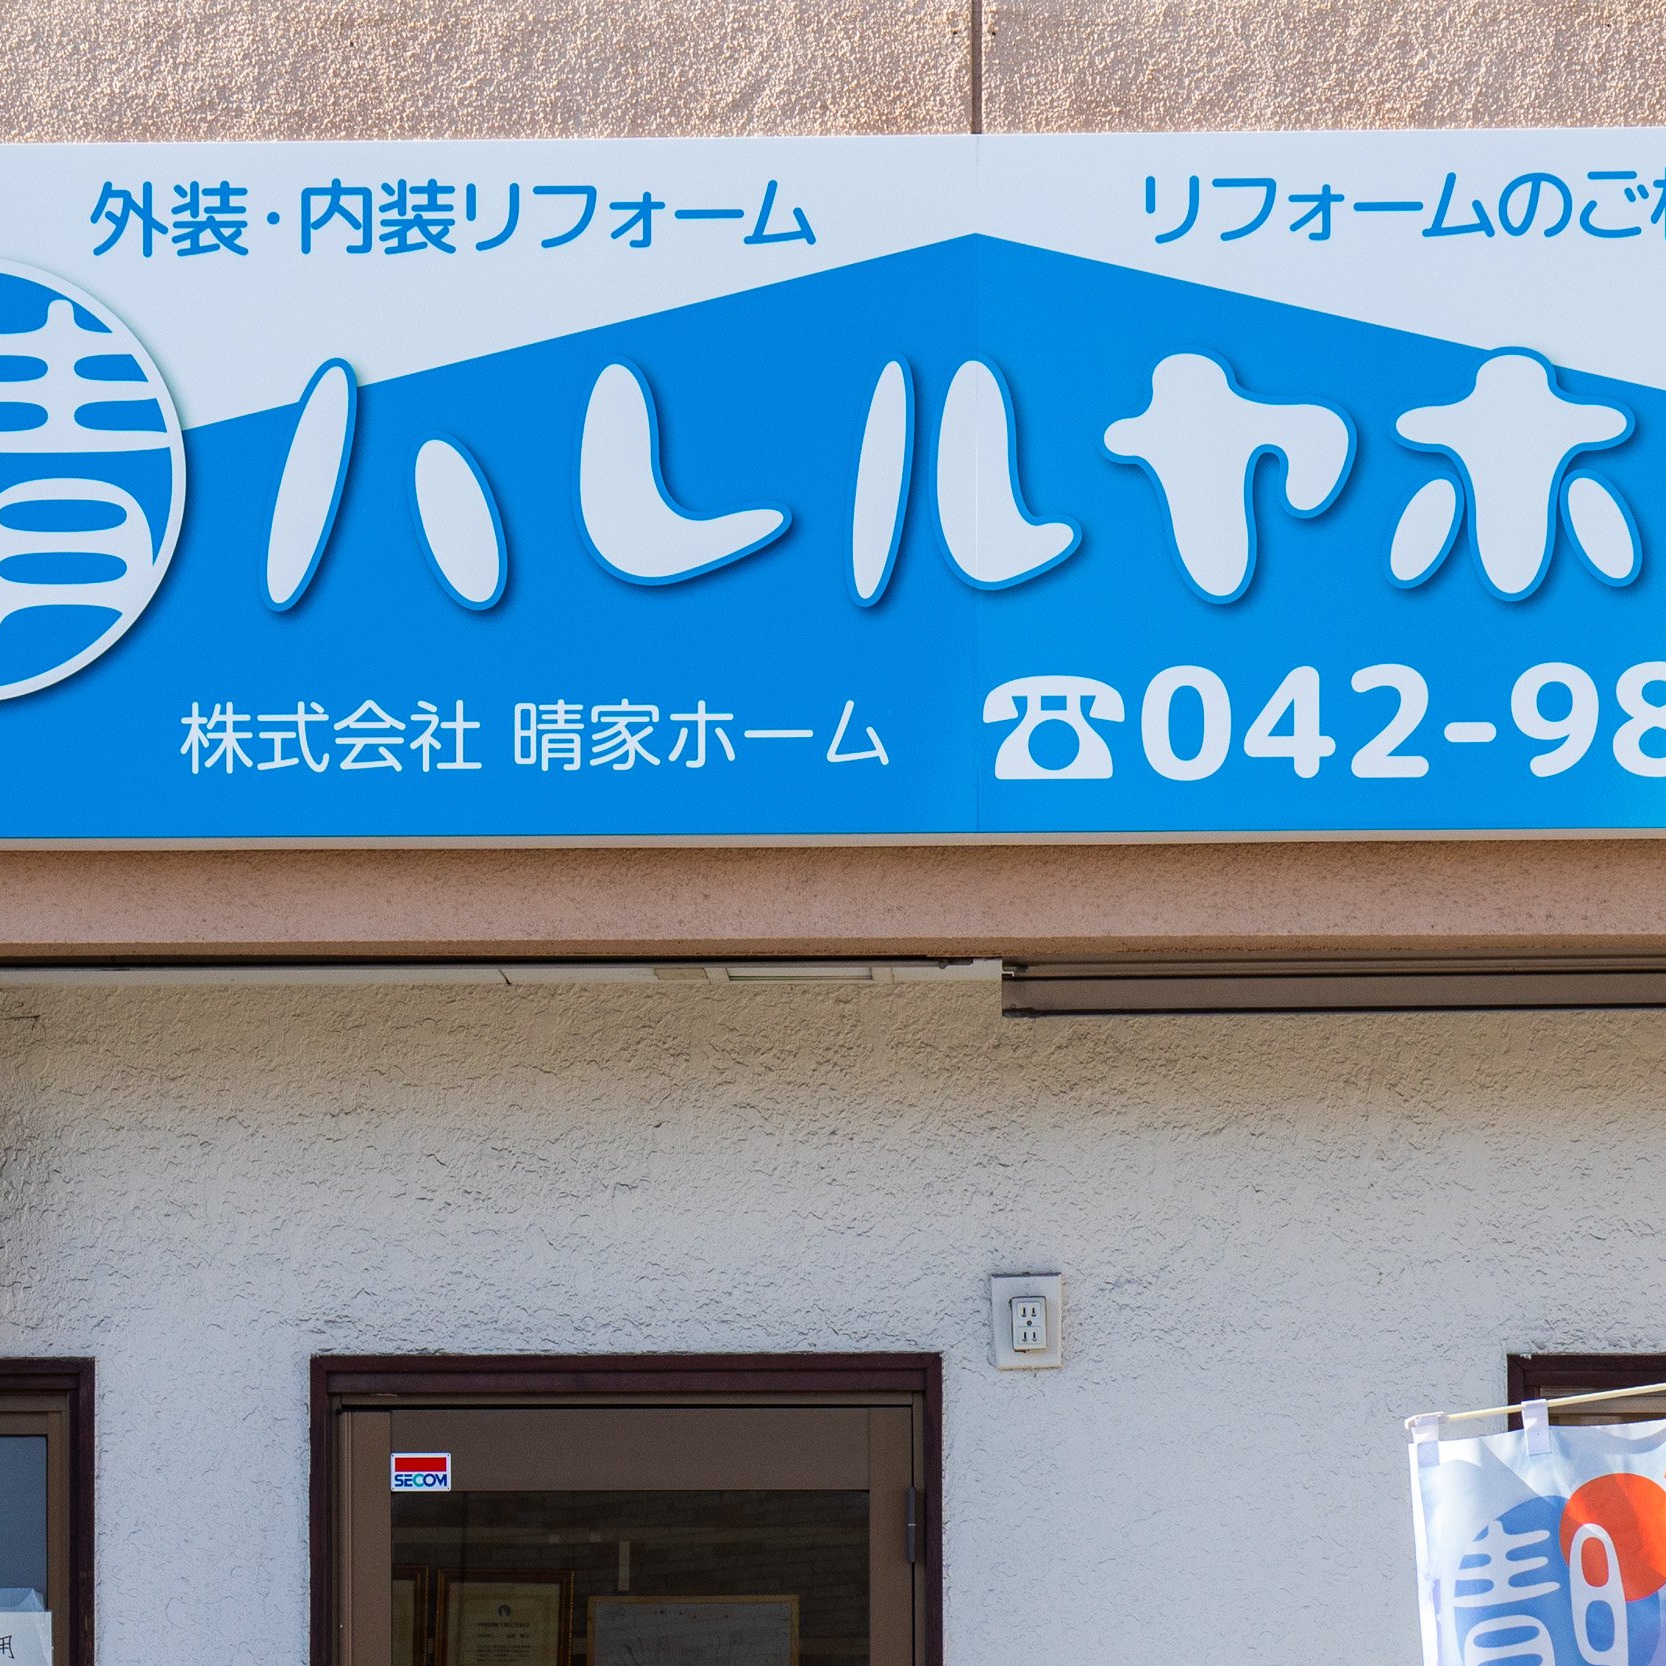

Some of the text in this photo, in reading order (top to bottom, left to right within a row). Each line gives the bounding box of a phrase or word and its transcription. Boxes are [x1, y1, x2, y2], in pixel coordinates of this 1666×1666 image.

[88, 179, 819, 259] 外装・内装リフォーム
[179, 699, 891, 776] 株式会社 晴家ホーム
[394, 1473, 448, 1488] SECOM
